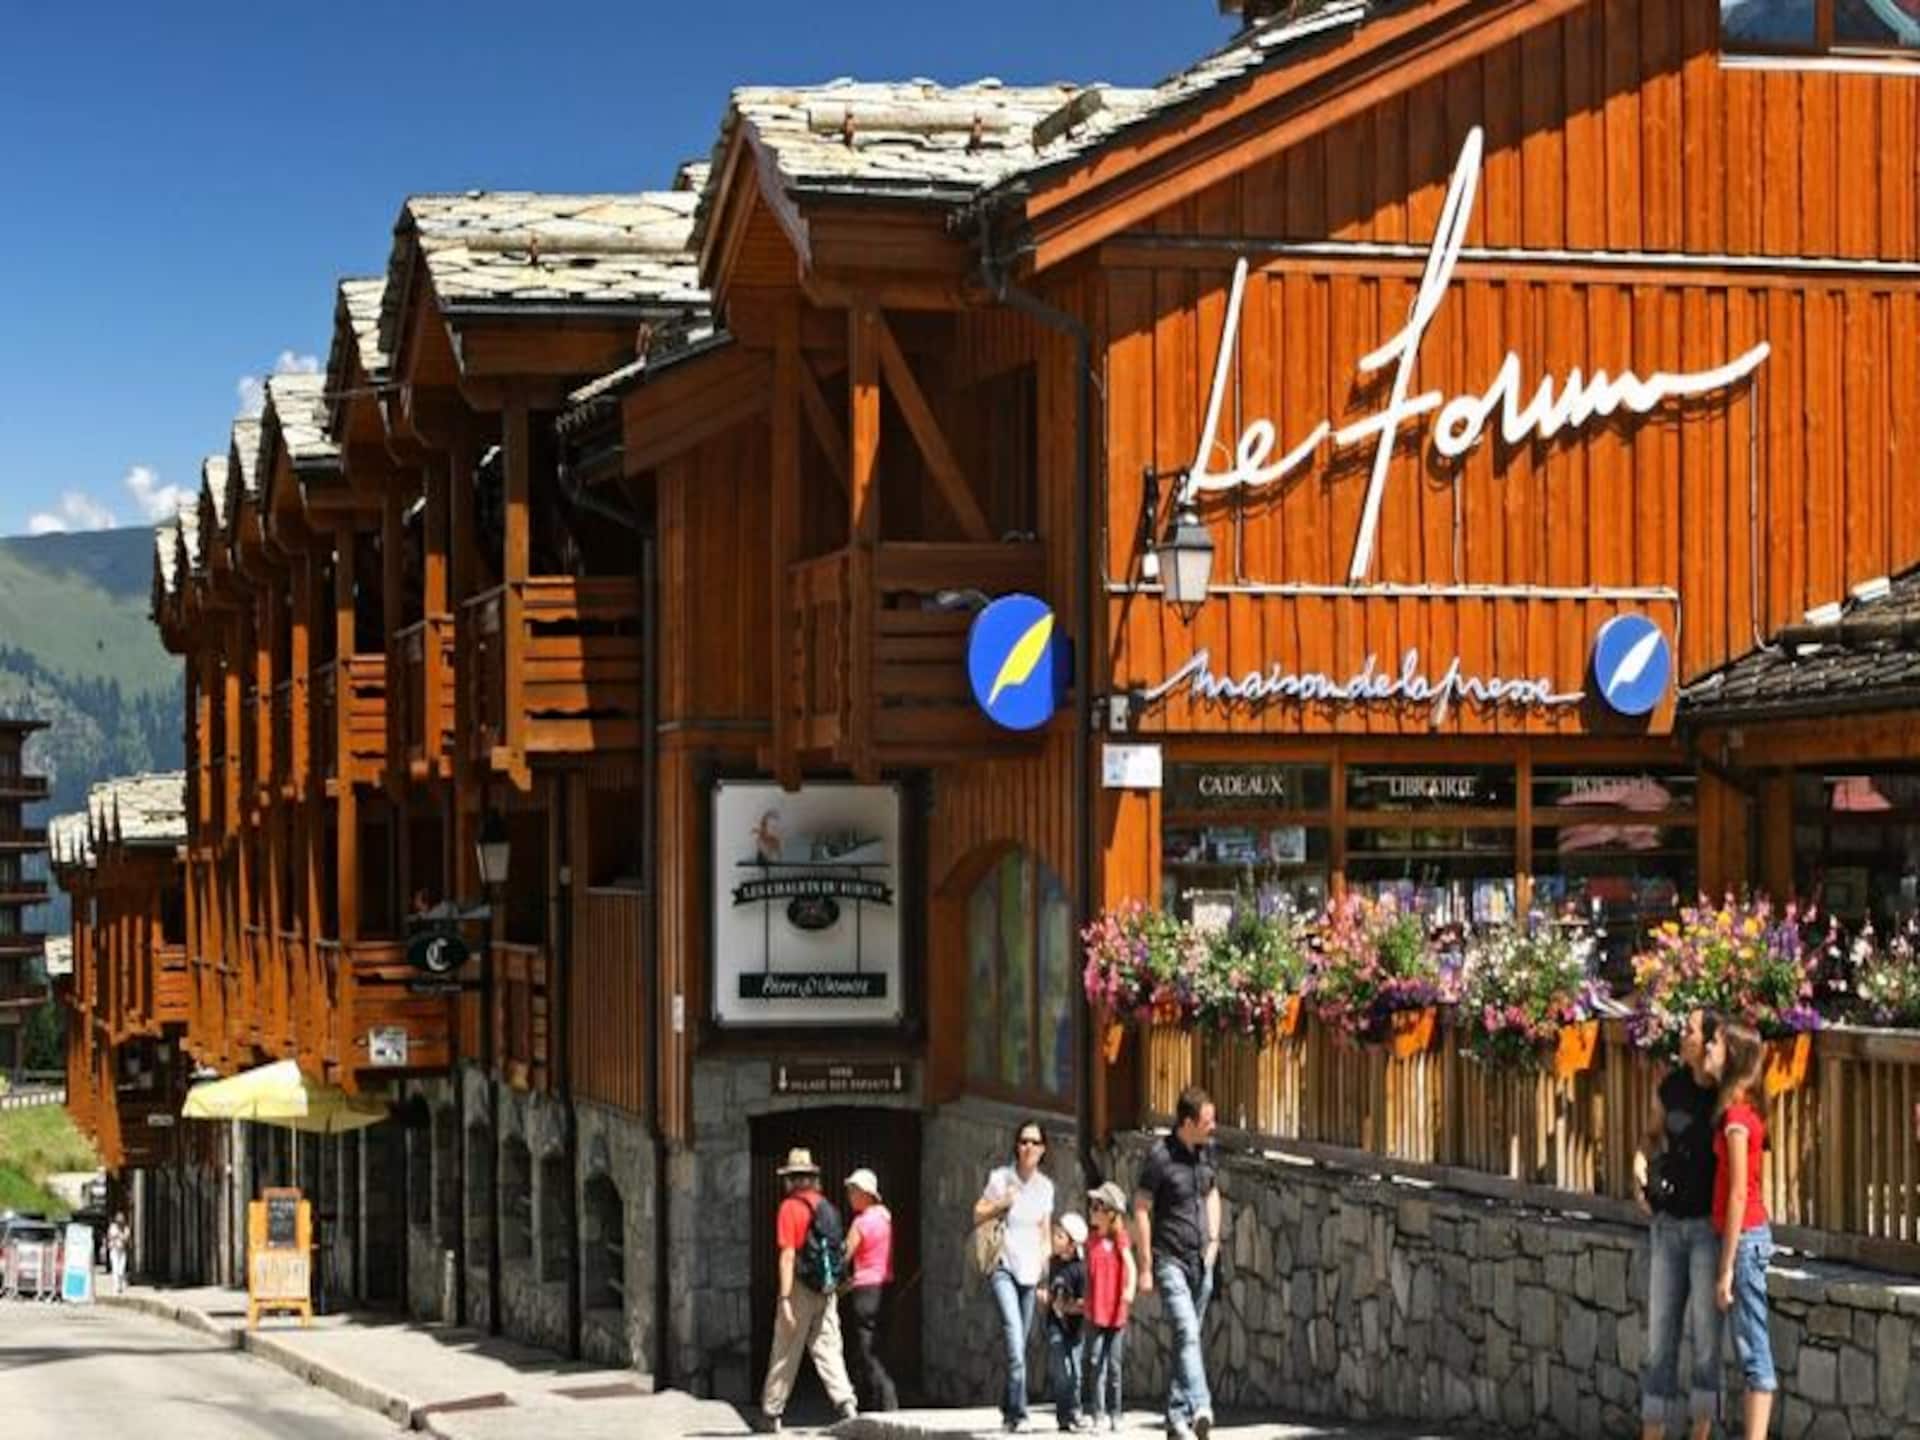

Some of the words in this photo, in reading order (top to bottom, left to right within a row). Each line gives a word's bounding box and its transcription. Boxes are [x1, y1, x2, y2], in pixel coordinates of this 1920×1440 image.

[1183, 257, 1331, 497] Le
[1332, 126, 1770, 583] Forum
[1198, 774, 1285, 797] CADEAUX
